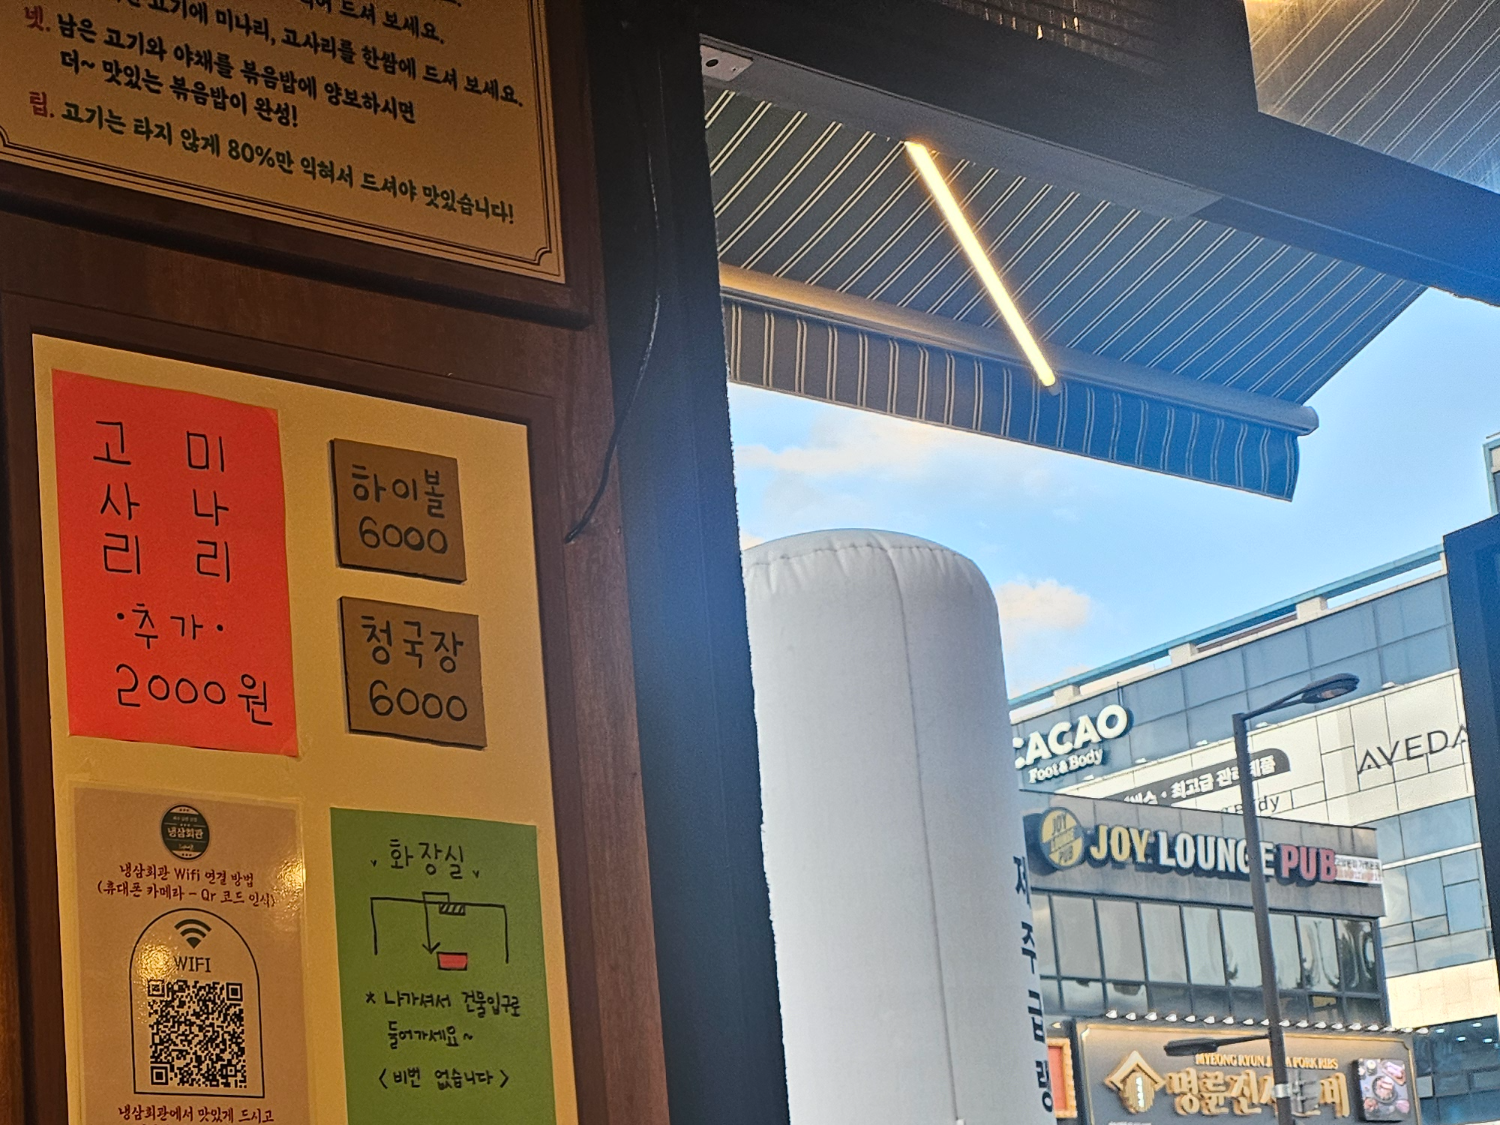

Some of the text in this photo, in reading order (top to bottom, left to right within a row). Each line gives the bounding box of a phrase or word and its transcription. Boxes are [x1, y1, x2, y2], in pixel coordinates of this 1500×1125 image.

[382, 11, 445, 44] 보세요.
[57, 13, 97, 43] 남은
[103, 27, 168, 62] 고기와
[173, 43, 234, 79] 야채를
[240, 59, 317, 100] 볶음밥에
[324, 82, 415, 124] 양보하시면
[215, 8, 276, 46] 미나리,
[281, 27, 355, 64] 고사리를
[422, 65, 458, 91] 드셔
[464, 74, 524, 107] 보세요.
[102, 59, 163, 94] 맛있는
[169, 75, 247, 116] 볶음밥이
[254, 97, 298, 128] 완성!
[61, 102, 126, 135] 고기는
[133, 116, 172, 146] 타지
[180, 127, 220, 157] 않게
[228, 138, 294, 175] 80%만
[300, 156, 353, 188] 익혀서
[360, 172, 417, 202] 드셔야
[422, 184, 514, 224] 맛있습니다!
[351, 465, 446, 519] 하이볼
[358, 515, 449, 555] 6000
[360, 615, 465, 674] 청국장
[368, 679, 469, 722] 6000
[1356, 724, 1467, 775] AVEDA
[119, 862, 254, 888] 냉삼회관 Wifi 연결 방법
[389, 838, 465, 880] 화장실
[1090, 824, 1150, 863] JOY
[1157, 830, 1276, 876] LOUNGE
[1280, 843, 1338, 882] PUB
[147, 883, 186, 901] 카메라
[201, 888, 217, 902] Qr
[220, 890, 245, 905] 코드
[173, 955, 211, 973] WIFI
[118, 1104, 275, 1124] 냉삼회관에서 맛있게 드시고
[1166, 1067, 1350, 1118] 명륜진비
